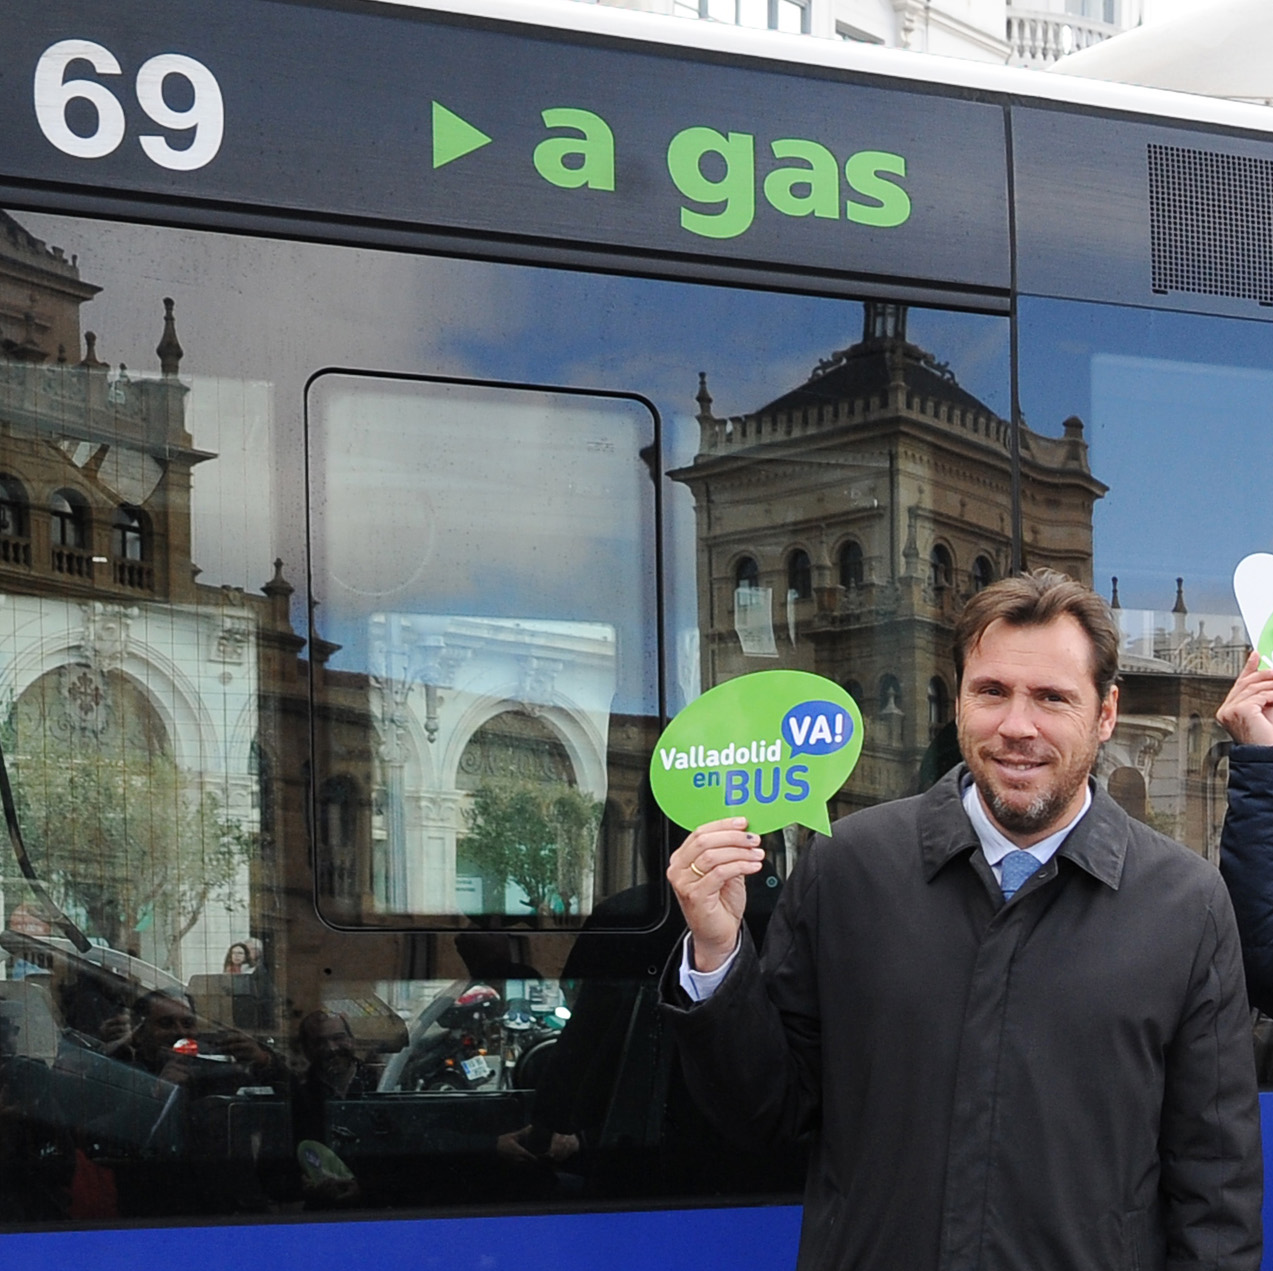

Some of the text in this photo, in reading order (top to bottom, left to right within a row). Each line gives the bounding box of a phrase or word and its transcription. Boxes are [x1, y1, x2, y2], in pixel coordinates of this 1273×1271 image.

[33, 39, 225, 171] 69
[533, 107, 913, 239] a gas
[659, 713, 843, 771] Valladolid VA!
[693, 765, 810, 806] en BUS
